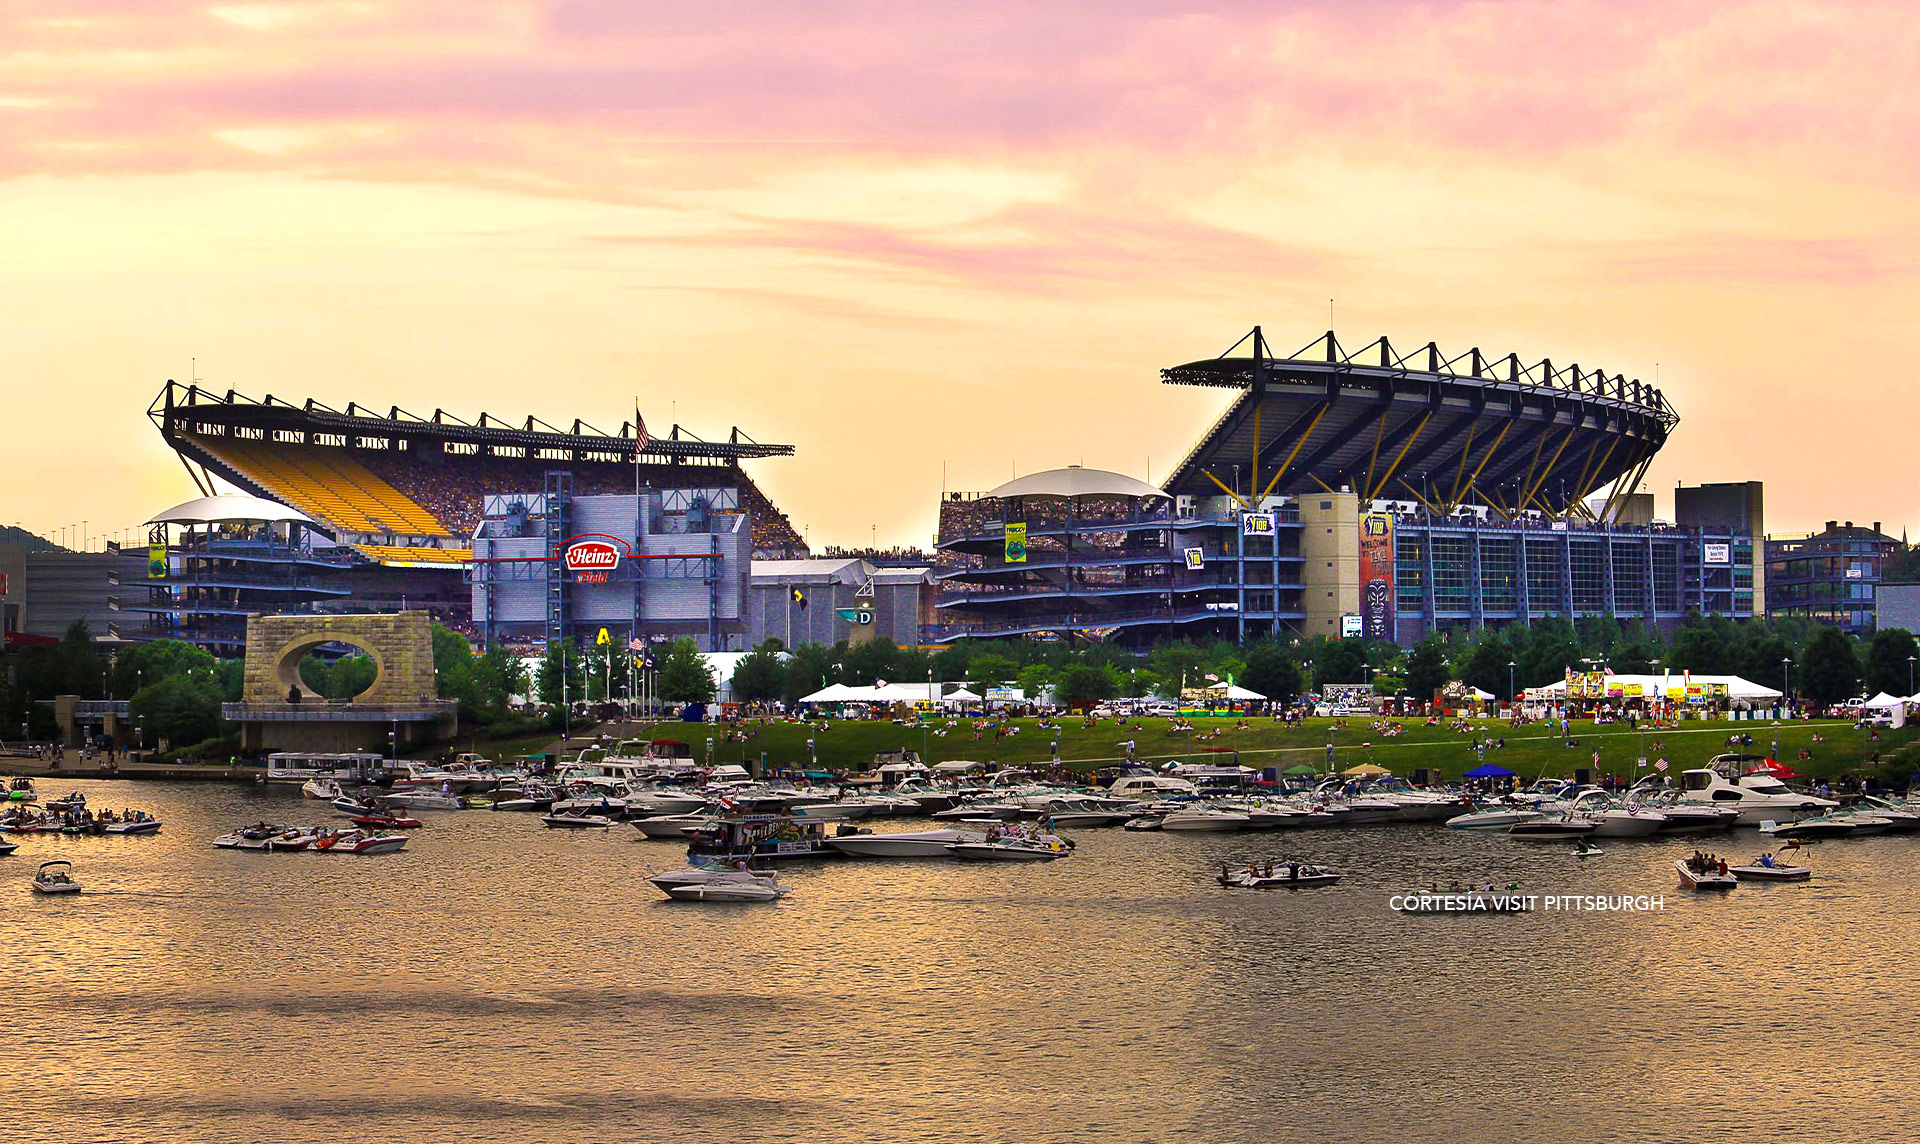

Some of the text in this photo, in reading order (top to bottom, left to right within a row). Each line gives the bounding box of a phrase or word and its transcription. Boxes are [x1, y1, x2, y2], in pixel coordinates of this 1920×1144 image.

[1361, 538, 1388, 549] WELCOME
[570, 548, 614, 564] Heinz
[576, 571, 608, 584] Field
[859, 612, 871, 624] D
